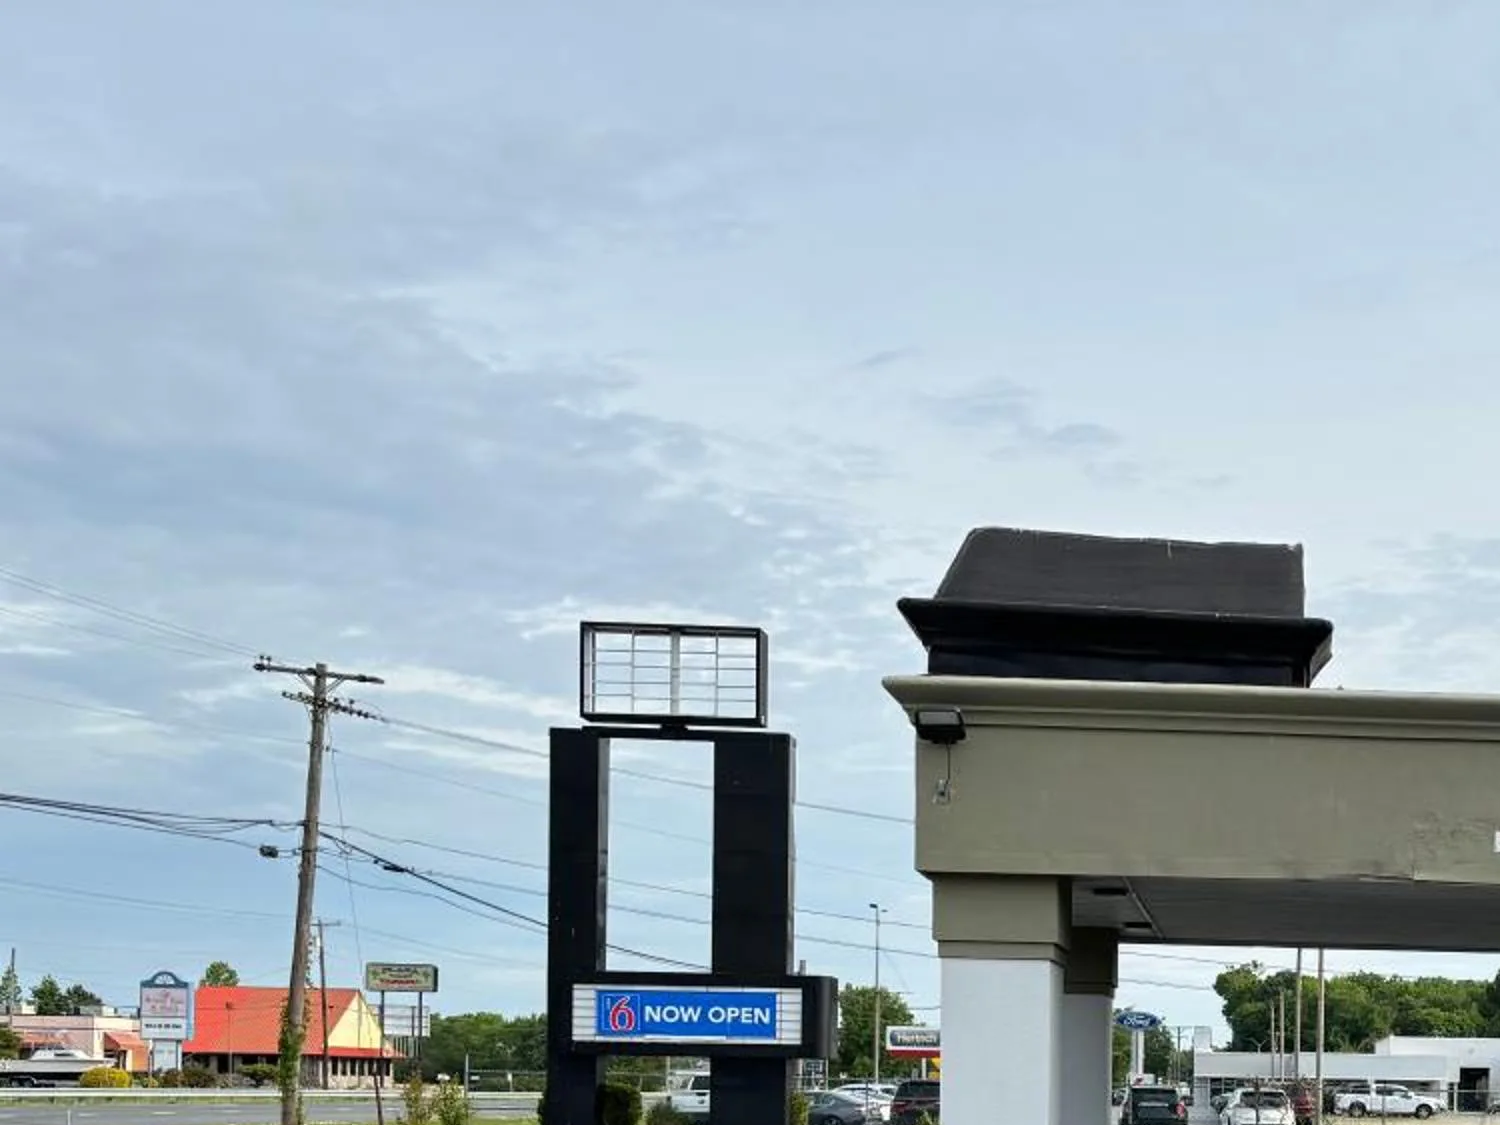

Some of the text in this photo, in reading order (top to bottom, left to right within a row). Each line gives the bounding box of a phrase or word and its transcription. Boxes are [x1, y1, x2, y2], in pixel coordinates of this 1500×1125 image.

[609, 995, 636, 1032] 6
[644, 1005, 771, 1025] NOW OPEN
